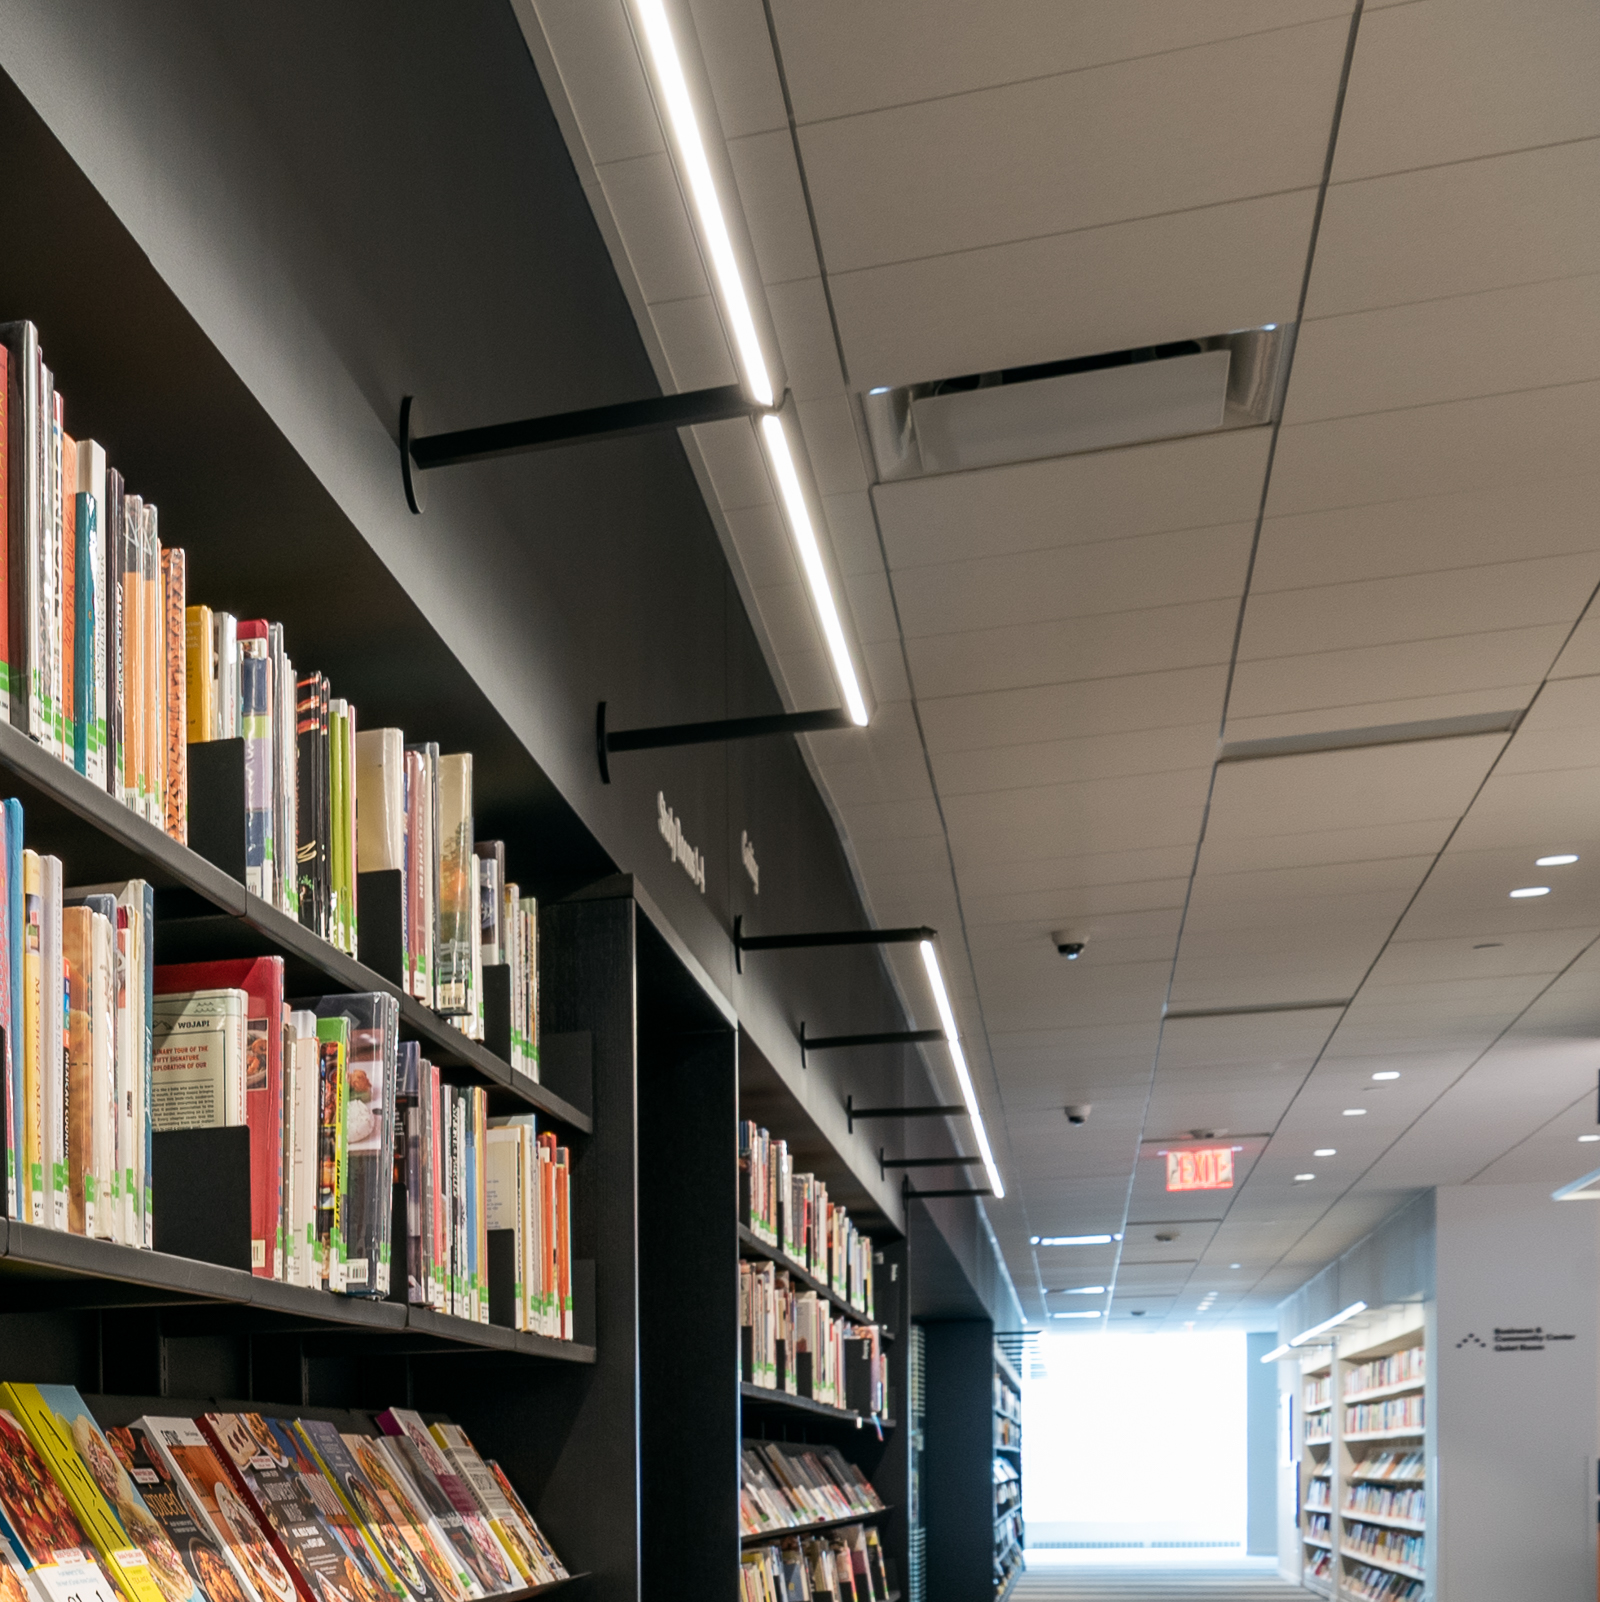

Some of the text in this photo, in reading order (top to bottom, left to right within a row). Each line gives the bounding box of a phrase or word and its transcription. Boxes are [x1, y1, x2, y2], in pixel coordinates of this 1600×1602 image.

[178, 1020, 210, 1029] WOJAPI
[173, 1046, 188, 1054] TOUR
[1179, 1151, 1221, 1184] EXIT
